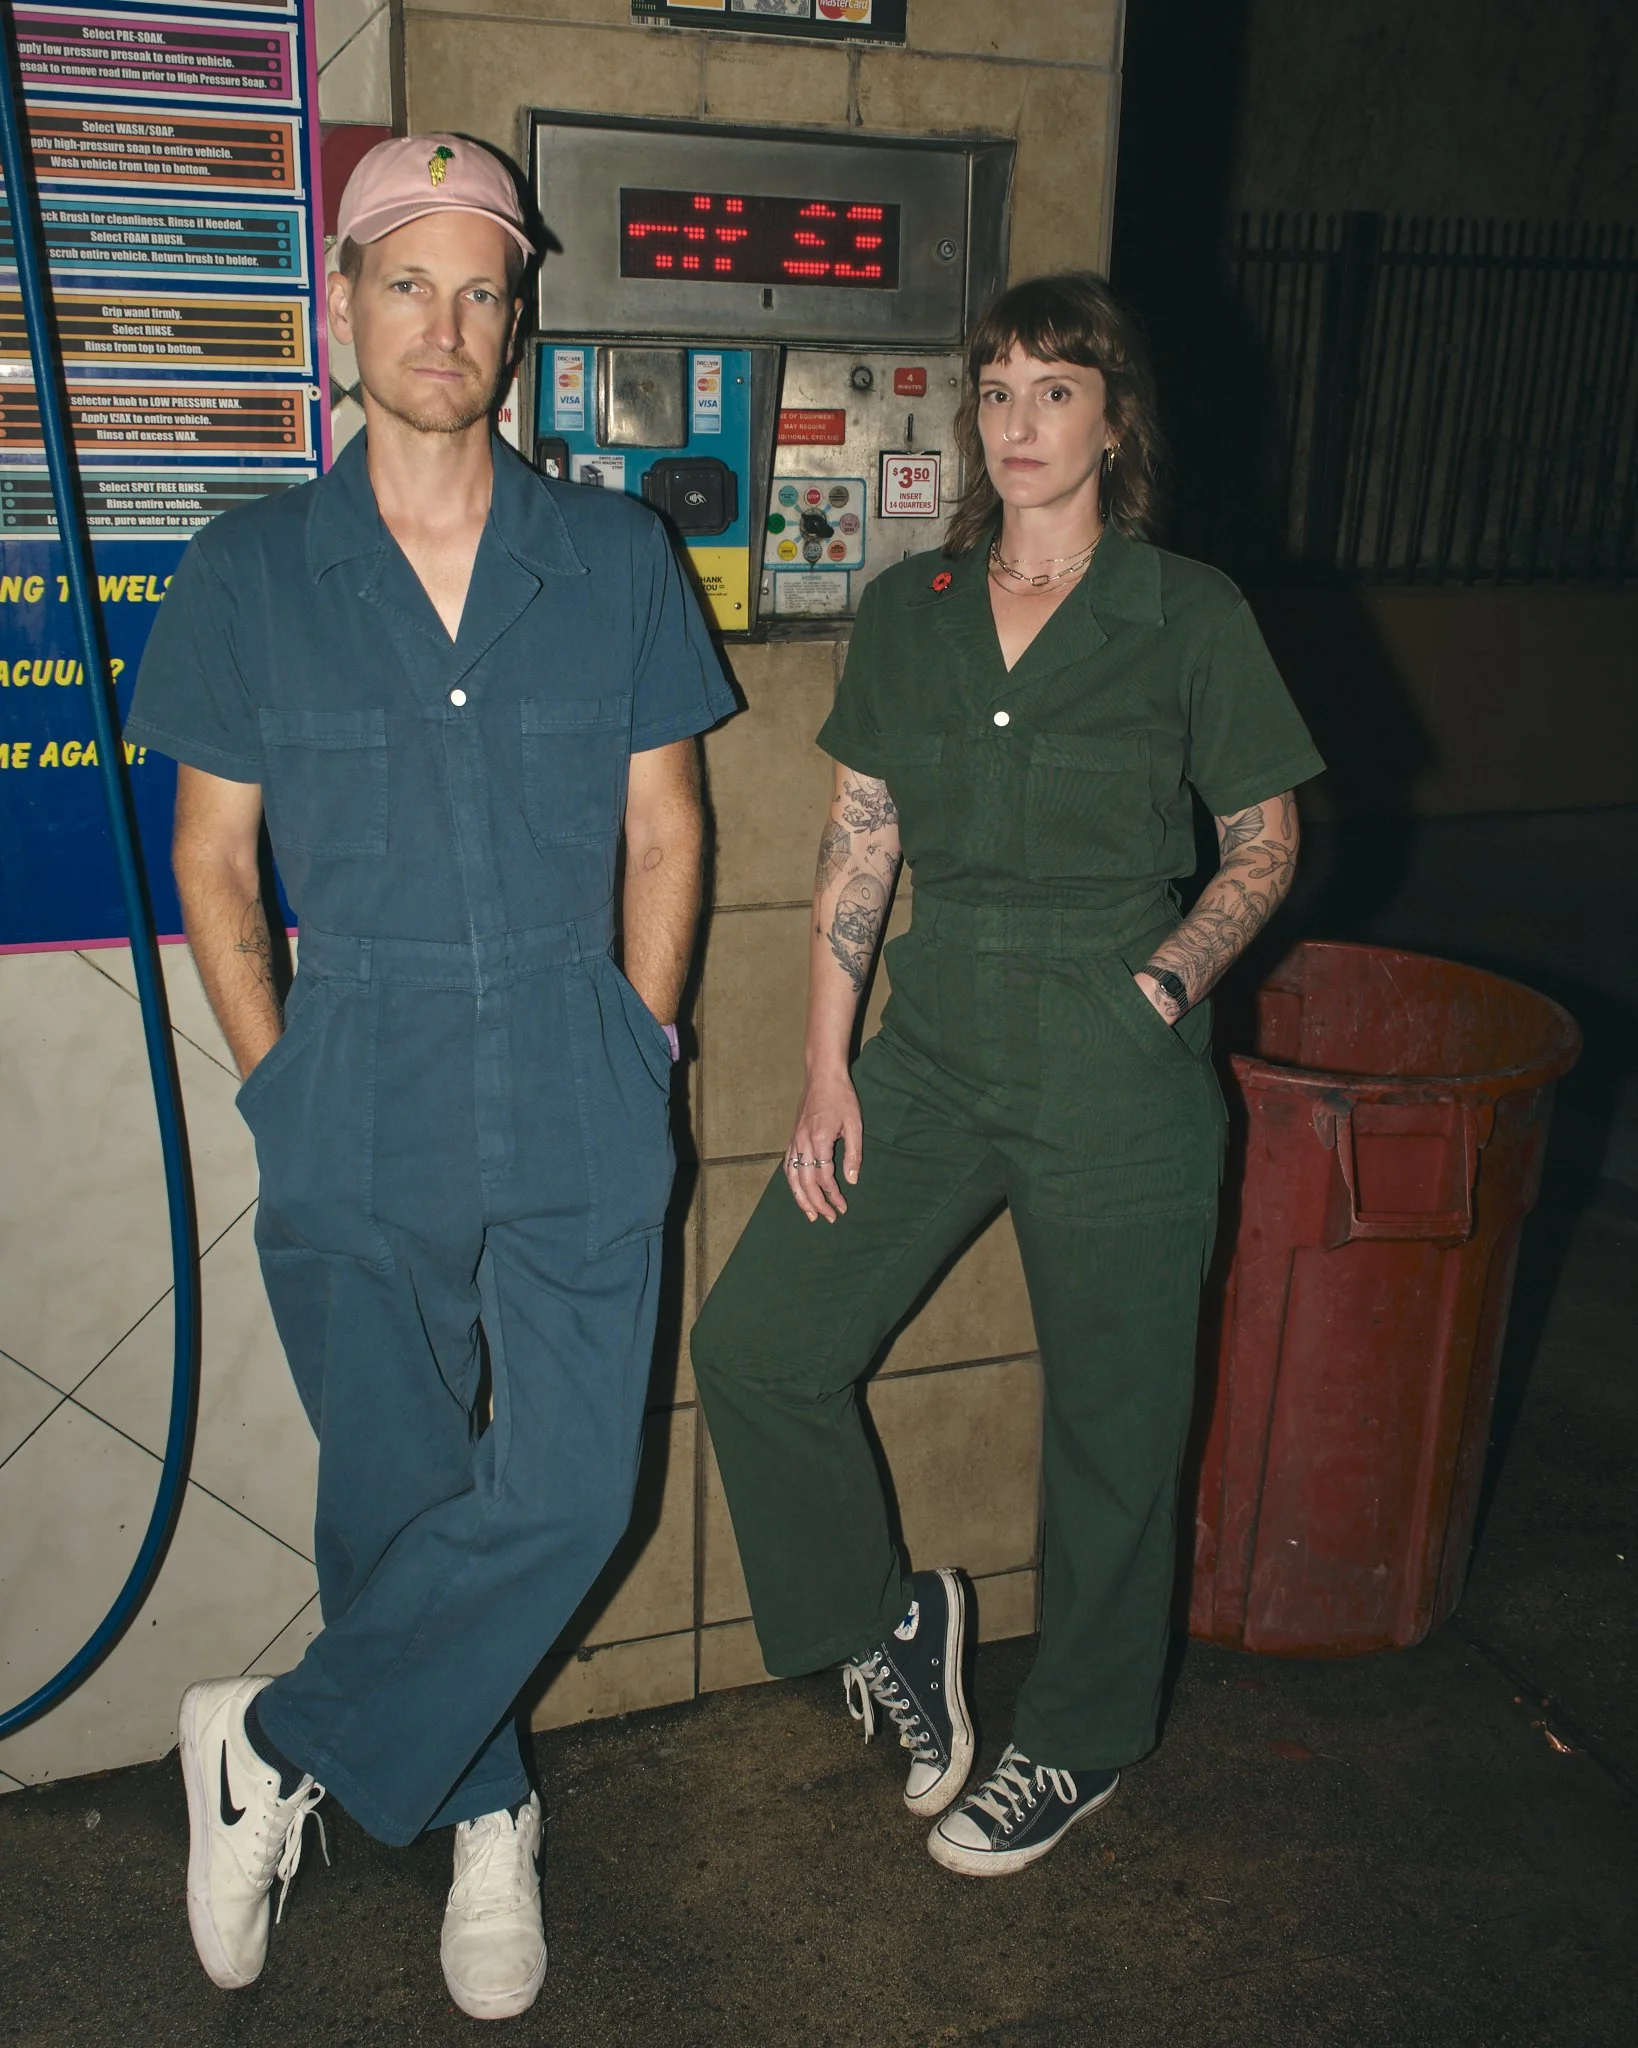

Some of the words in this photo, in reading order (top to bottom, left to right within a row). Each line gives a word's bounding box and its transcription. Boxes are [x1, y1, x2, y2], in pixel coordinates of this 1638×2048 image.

[82, 28, 115, 40] Select
[116, 30, 165, 44] PRE-SOAK.
[43, 43, 61, 55] low
[63, 47, 109, 58] pressure
[111, 50, 151, 63] presoak
[153, 52, 163, 63] to
[165, 54, 194, 65] entire
[196, 56, 234, 68] vehicle.
[50, 64, 60, 73] to
[61, 65, 97, 76] remove
[99, 68, 120, 80] road
[122, 68, 140, 79] film
[142, 70, 165, 81] prior
[166, 72, 176, 81] to
[177, 72, 198, 84] High
[200, 74, 240, 86] Pressure
[242, 77, 267, 88] Soap.
[83, 121, 114, 133] Select
[116, 123, 174, 136] WASH/SOAP.
[54, 138, 124, 152] high-pressure
[127, 144, 150, 154] soap
[153, 145, 162, 154] to
[164, 146, 193, 156] entire
[195, 147, 232, 158] vehicle.
[51, 156, 79, 168] Wash
[81, 159, 117, 170] vehicle
[119, 160, 142, 171] from
[144, 162, 160, 173] top
[162, 163, 171, 173] to
[174, 163, 210, 175] bottom.
[60, 211, 89, 223] Brush
[91, 213, 105, 223] for
[107, 214, 167, 226] cleanliness.
[168, 217, 195, 228] Rinse
[197, 218, 203, 228] if
[205, 218, 243, 230] Needed.
[90, 231, 122, 242] Select
[123, 232, 149, 243] FOAM
[151, 234, 185, 245] BRUSH.
[50, 248, 78, 258] scrub
[80, 249, 110, 260] entire
[111, 250, 150, 261] vehicle.
[151, 252, 184, 263] Return
[185, 253, 213, 264] brush
[215, 255, 224, 264] to
[226, 255, 259, 266] holder.
[102, 306, 122, 317] Grip
[124, 308, 150, 317] wand
[152, 308, 182, 319] firmly.
[113, 324, 143, 335] Select
[145, 326, 174, 336] RINSE.
[85, 341, 112, 351] Rinse
[114, 342, 137, 352] from
[139, 343, 154, 353] top
[156, 344, 165, 353] to
[168, 344, 203, 354] bottom.
[906, 374, 913, 382] 4
[71, 396, 111, 405] selector
[113, 396, 137, 406] knob
[138, 398, 148, 406] to
[150, 397, 170, 407] LOW
[172, 398, 217, 408] PRESSURE
[218, 399, 242, 408] WAX.
[560, 395, 580, 405] VISA
[698, 399, 718, 408] VISA
[82, 413, 108, 423] Apply
[110, 413, 131, 423] WAX
[133, 414, 142, 423] to
[144, 414, 173, 424] entire
[174, 415, 211, 424] vehicle.
[97, 430, 124, 440] Rinse
[126, 431, 138, 440] off
[140, 432, 173, 440] excess
[175, 432, 198, 441] WAX.
[99, 482, 130, 492] Select
[131, 483, 154, 492] SPOT
[157, 483, 177, 492] FREE
[179, 483, 207, 492] RINSE.
[107, 499, 133, 508] Rinse
[135, 500, 163, 508] entire
[165, 500, 202, 509] vehicle.
[889, 501, 898, 509] 14
[898, 501, 932, 510] QUARTERS
[115, 517, 136, 526] pure
[138, 517, 165, 525] water
[167, 516, 180, 525] for
[57, 575, 173, 602] TWEL
[40, 741, 147, 768] AGAN!
